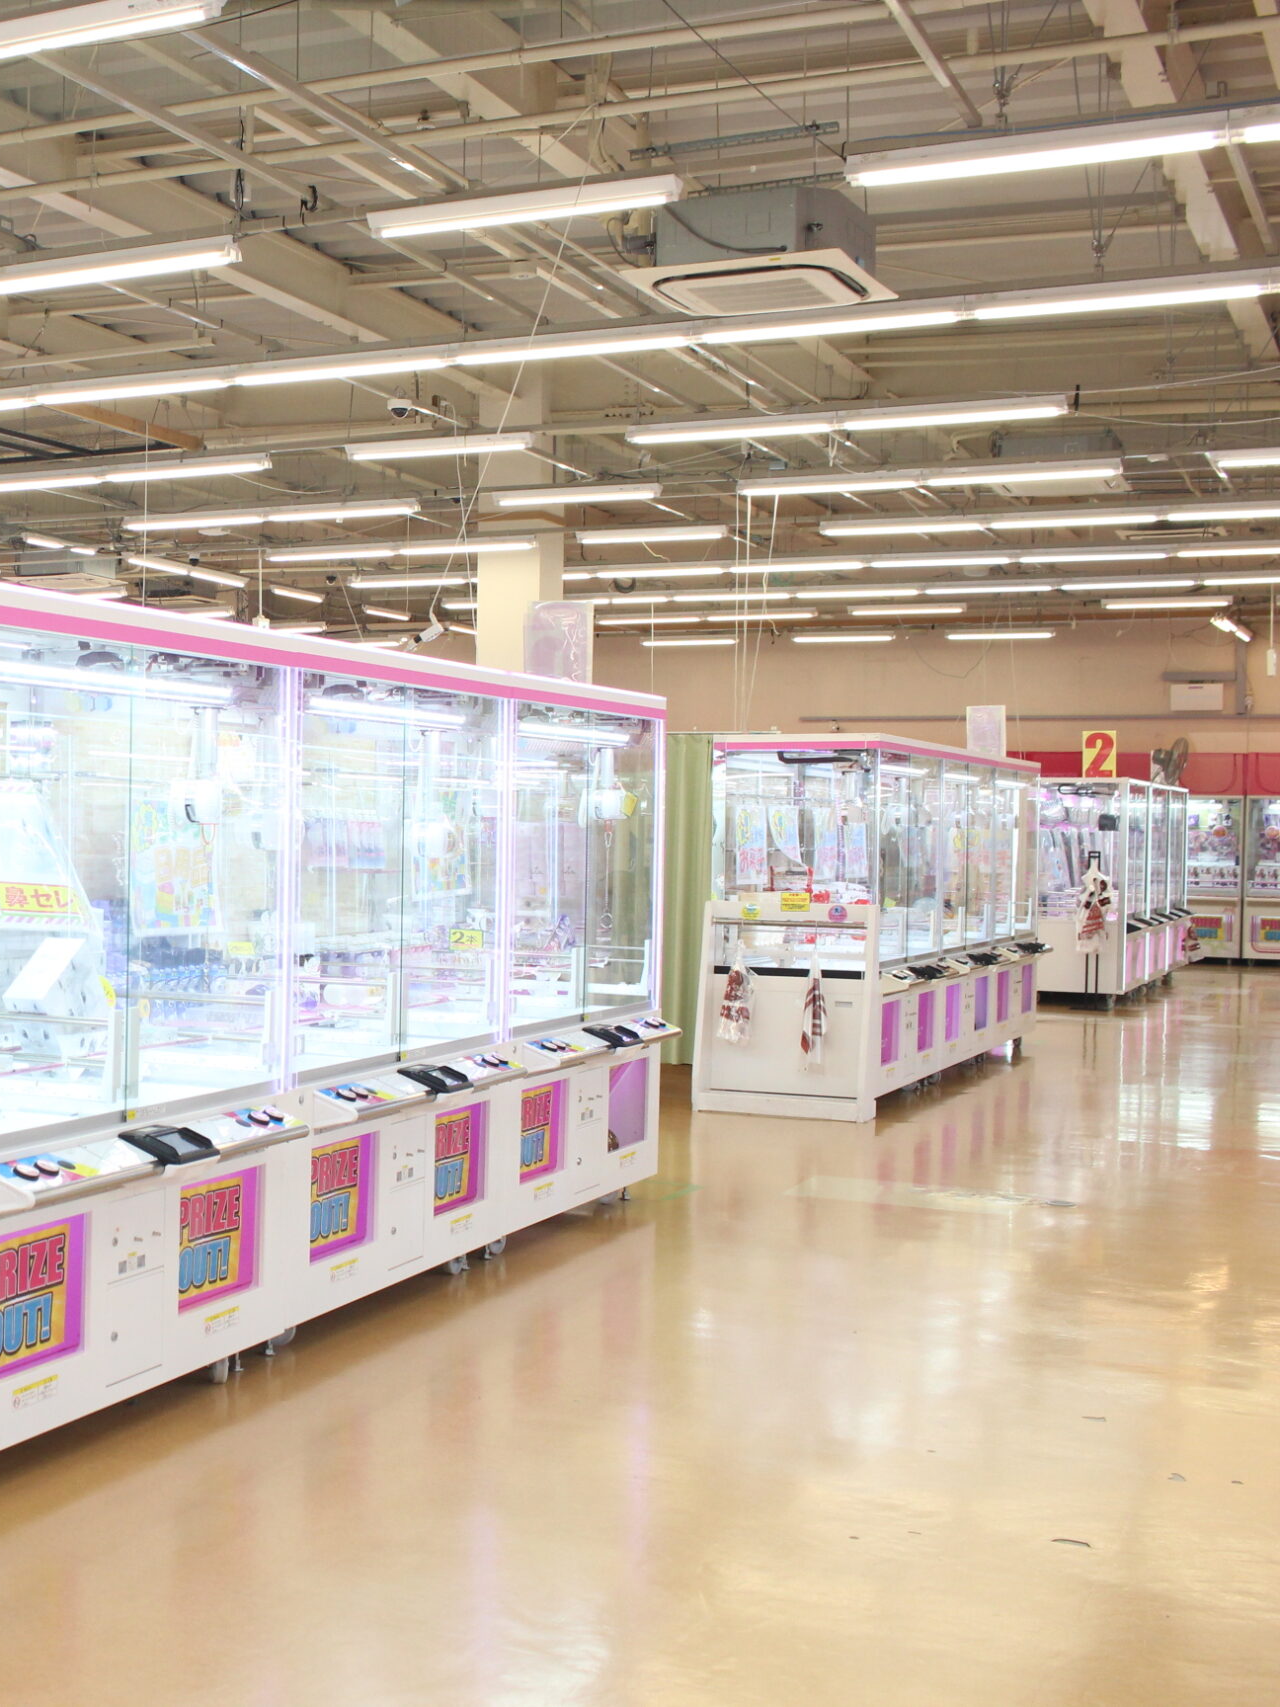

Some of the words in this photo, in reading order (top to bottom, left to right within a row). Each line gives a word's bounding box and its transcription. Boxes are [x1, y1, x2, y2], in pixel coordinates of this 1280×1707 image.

[1085, 732, 1114, 777] 2
[4, 886, 77, 909] 鼻セレ
[521, 1090, 551, 1132] RIZE
[435, 1116, 470, 1162] RIZE
[435, 1158, 464, 1199] UT!
[180, 1185, 240, 1245] PRIZE
[310, 1191, 350, 1242] OUT!
[179, 1235, 231, 1293] OUT!
